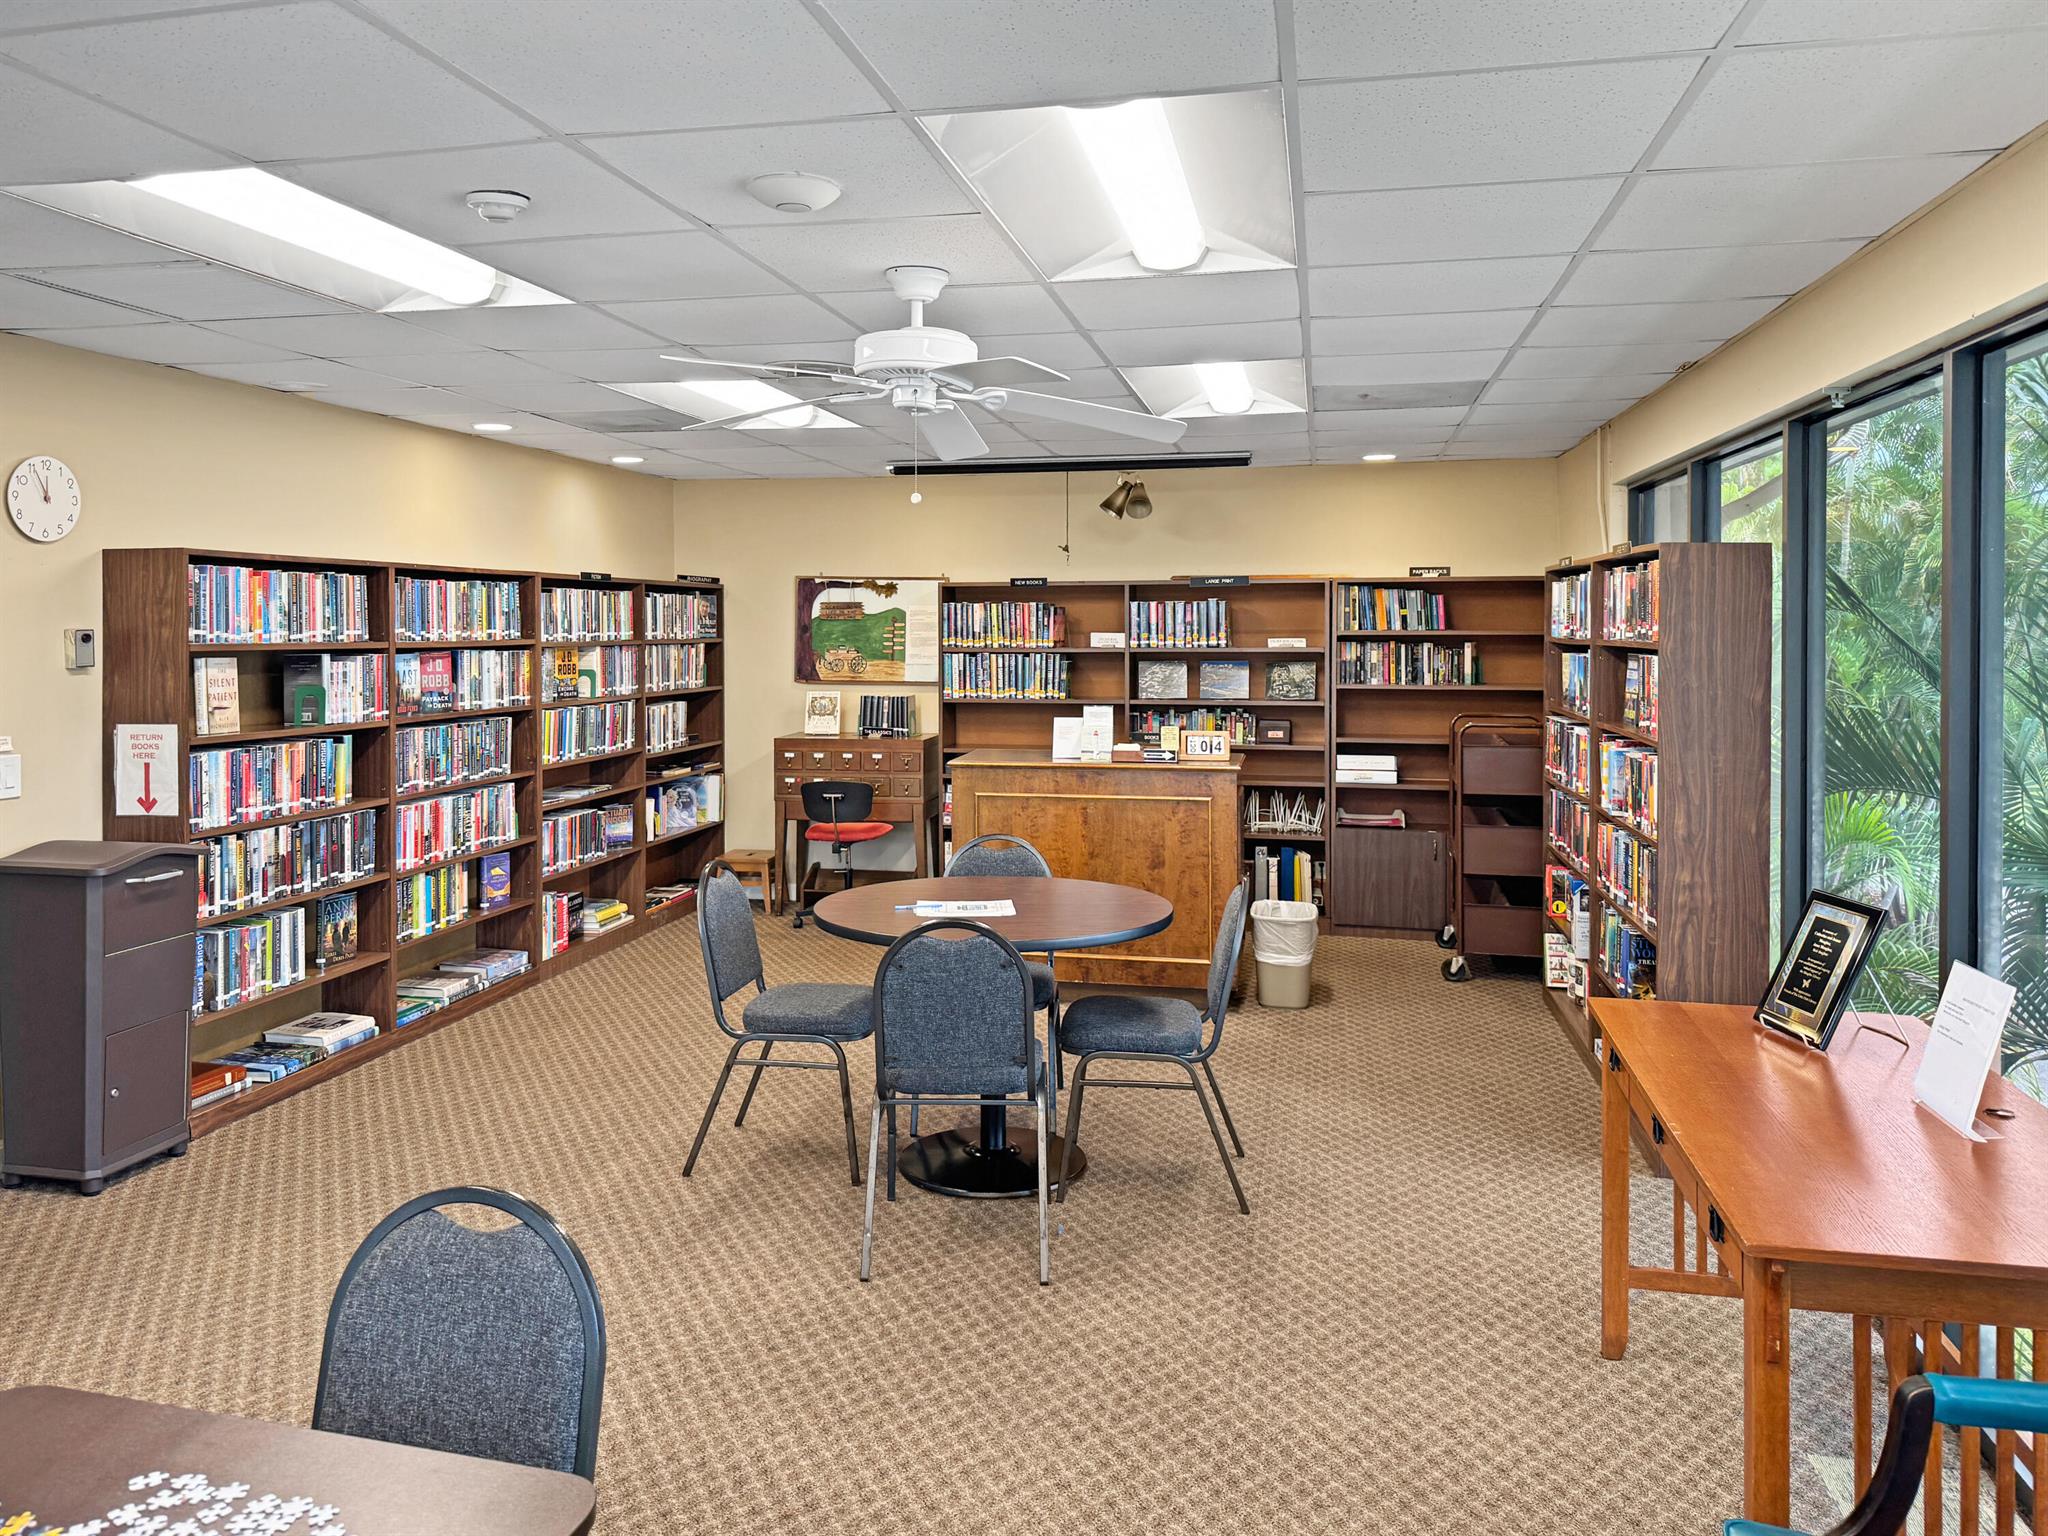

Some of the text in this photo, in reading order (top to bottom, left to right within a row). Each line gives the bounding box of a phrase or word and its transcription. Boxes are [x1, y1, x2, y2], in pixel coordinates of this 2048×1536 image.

[28, 463, 36, 474] 11
[41, 460, 51, 471] 12
[59, 467, 62, 477] 1
[16, 475, 28, 485] 10
[67, 478, 74, 489] 2
[12, 490, 19, 501] 9
[72, 495, 78, 506] 3
[16, 508, 22, 519] 8
[67, 514, 73, 522] 4
[28, 522, 34, 532] 7
[57, 523, 63, 535] 5
[42, 528, 49, 538] 6
[558, 663, 576, 675] ROBB
[209, 678, 235, 688] SILENT
[421, 674, 449, 688] ROBB
[208, 692, 237, 702] PATIENT
[325, 898, 354, 914] ANNE
